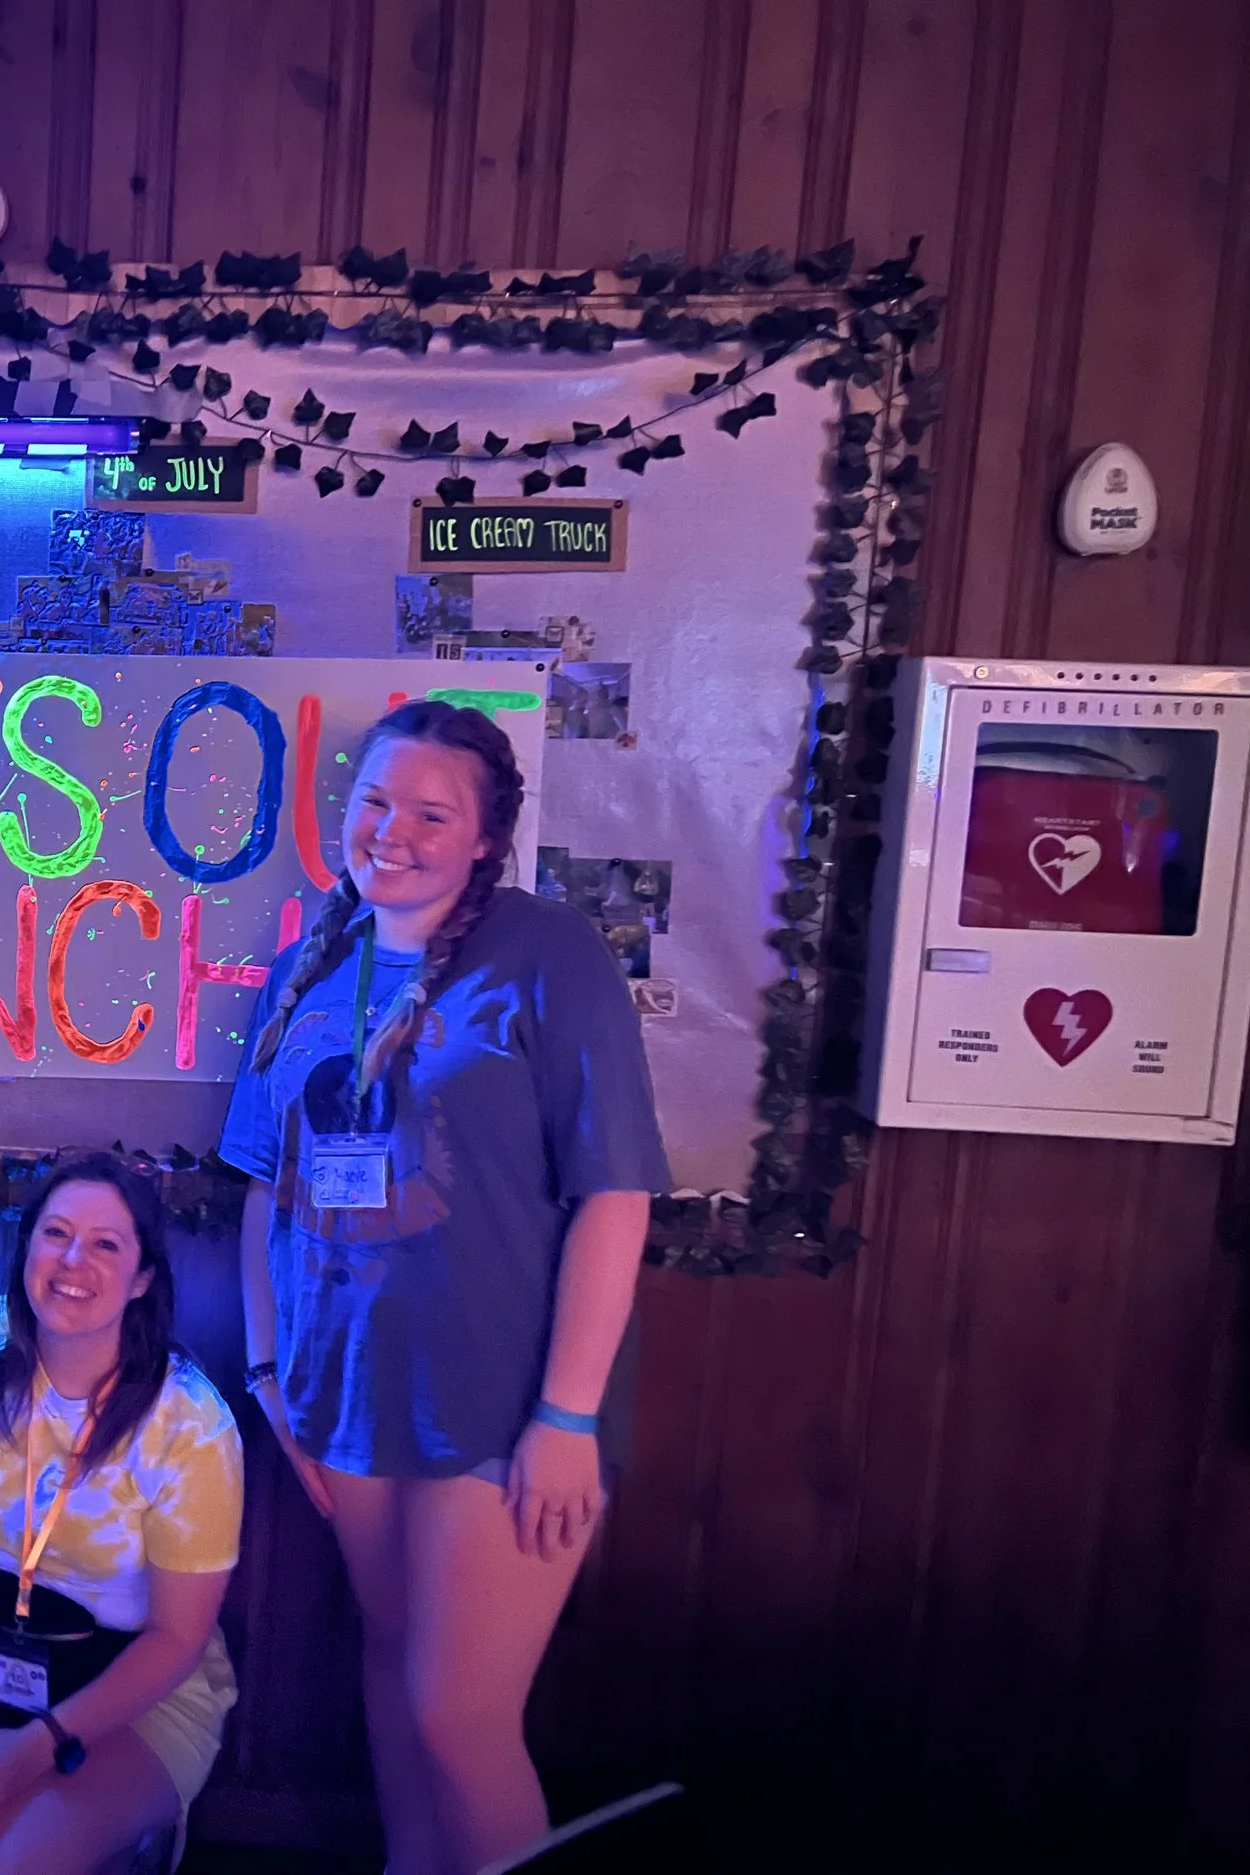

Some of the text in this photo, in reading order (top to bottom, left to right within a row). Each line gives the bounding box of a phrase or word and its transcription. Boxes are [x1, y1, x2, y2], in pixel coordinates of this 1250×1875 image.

[104, 456, 224, 494] 4th OF JULY
[430, 517, 606, 552] ICE CREAM TRUCK
[982, 700, 1225, 716] DEFIBRILLATOR
[951, 1029, 990, 1039] TRAINED
[939, 1041, 998, 1052] RESPONDERS
[1134, 1040, 1168, 1050] ALARM
[955, 1054, 979, 1062] ONLY
[1139, 1053, 1161, 1062] WILL
[1132, 1065, 1164, 1073] SOUND
